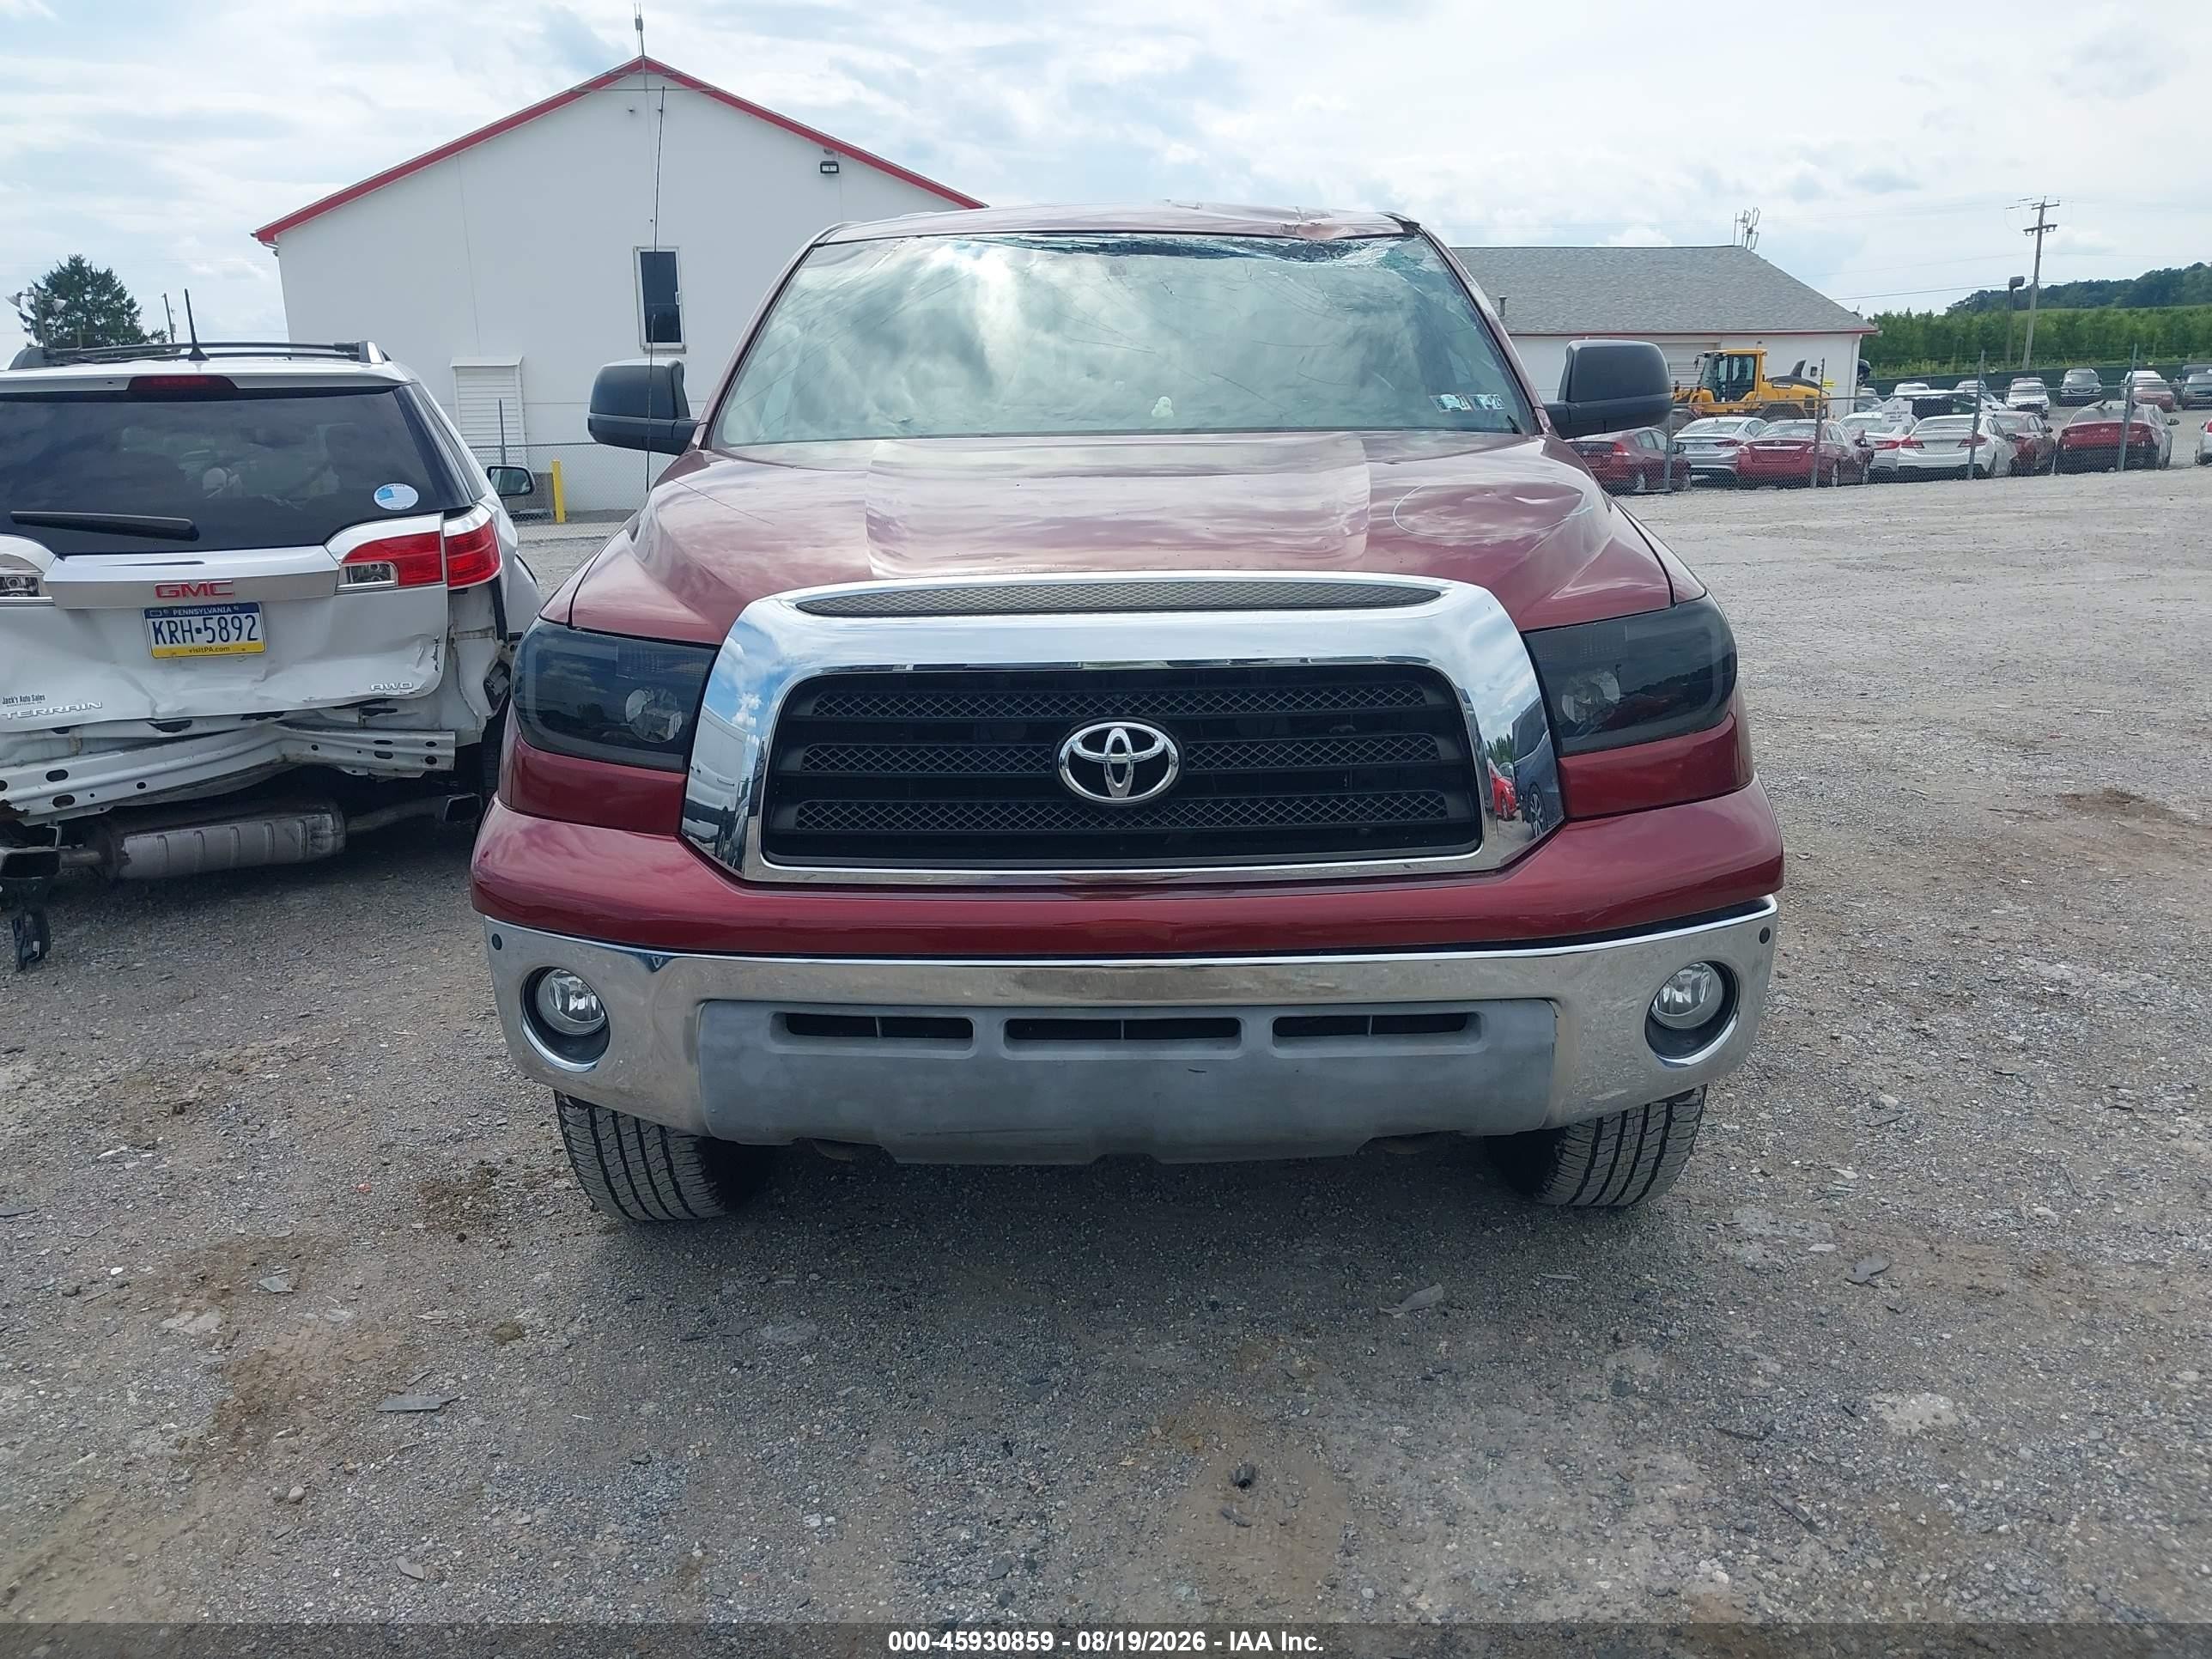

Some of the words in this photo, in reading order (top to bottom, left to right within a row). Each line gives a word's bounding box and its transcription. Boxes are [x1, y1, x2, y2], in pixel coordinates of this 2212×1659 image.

[155, 580, 234, 599] GMC
[173, 606, 232, 616] PENNSYLVANIA
[188, 645, 230, 653] visitPA.com
[370, 682, 413, 691] AWD
[2, 701, 103, 720] TERRAIN
